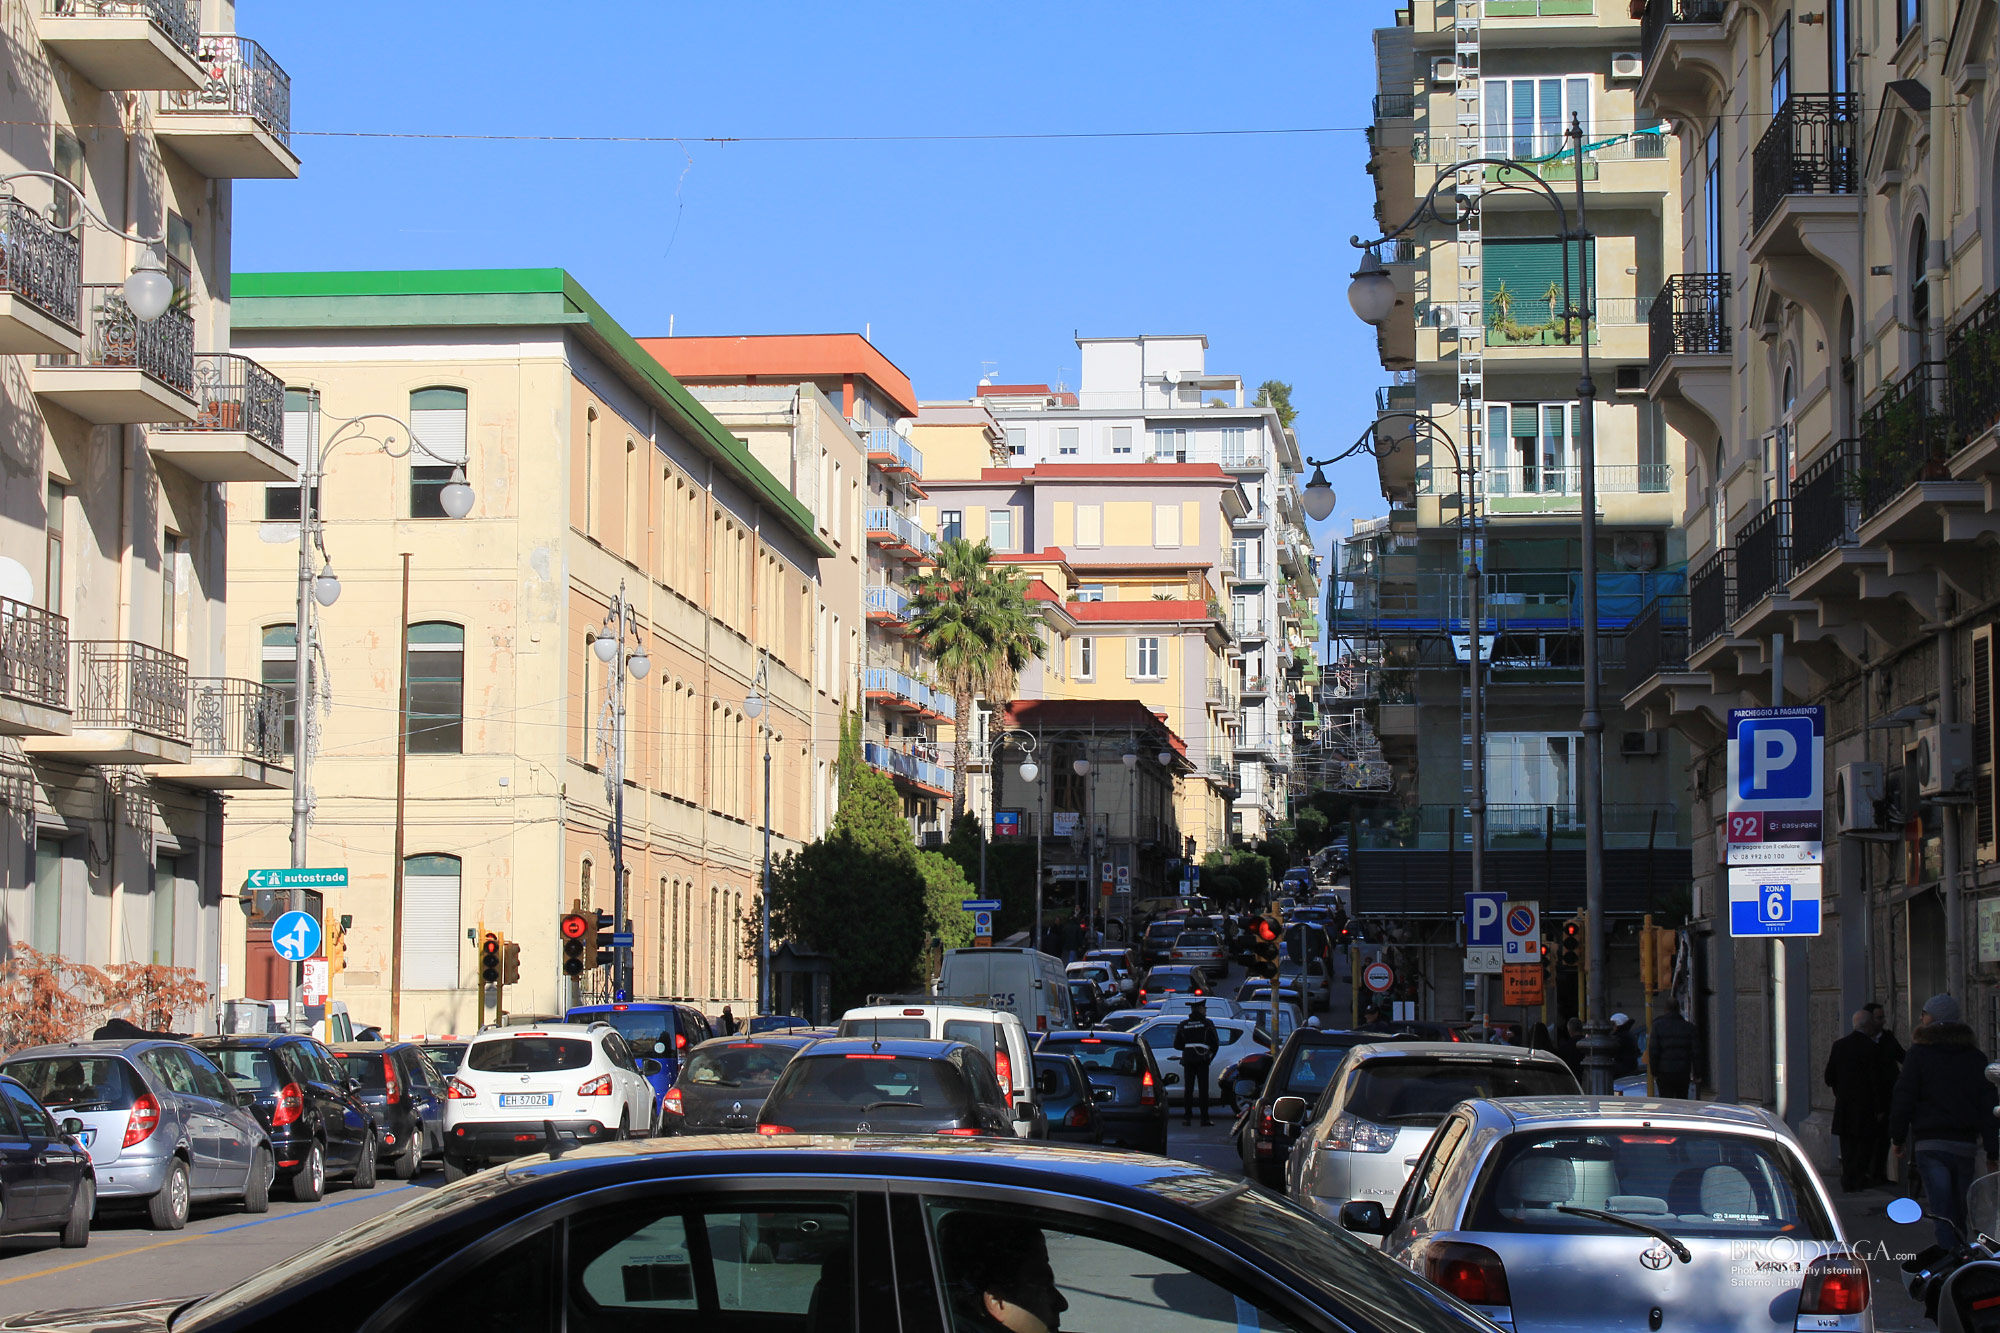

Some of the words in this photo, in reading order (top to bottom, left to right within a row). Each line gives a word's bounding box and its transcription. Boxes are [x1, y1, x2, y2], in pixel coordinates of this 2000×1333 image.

[1734, 709, 1773, 717] PARCHEGGIO
[1779, 707, 1818, 715] PAGAMENTO
[1753, 729, 1797, 789] P
[1732, 817, 1758, 836] 92
[284, 872, 345, 883] autostrade
[1766, 892, 1784, 920] 6
[1472, 898, 1498, 940] P
[1509, 943, 1516, 952] P
[1510, 977, 1537, 986] Prendi
[505, 1095, 517, 1105] EH
[519, 1095, 547, 1105] 370ZB
[1755, 1261, 1788, 1272] YARIS
